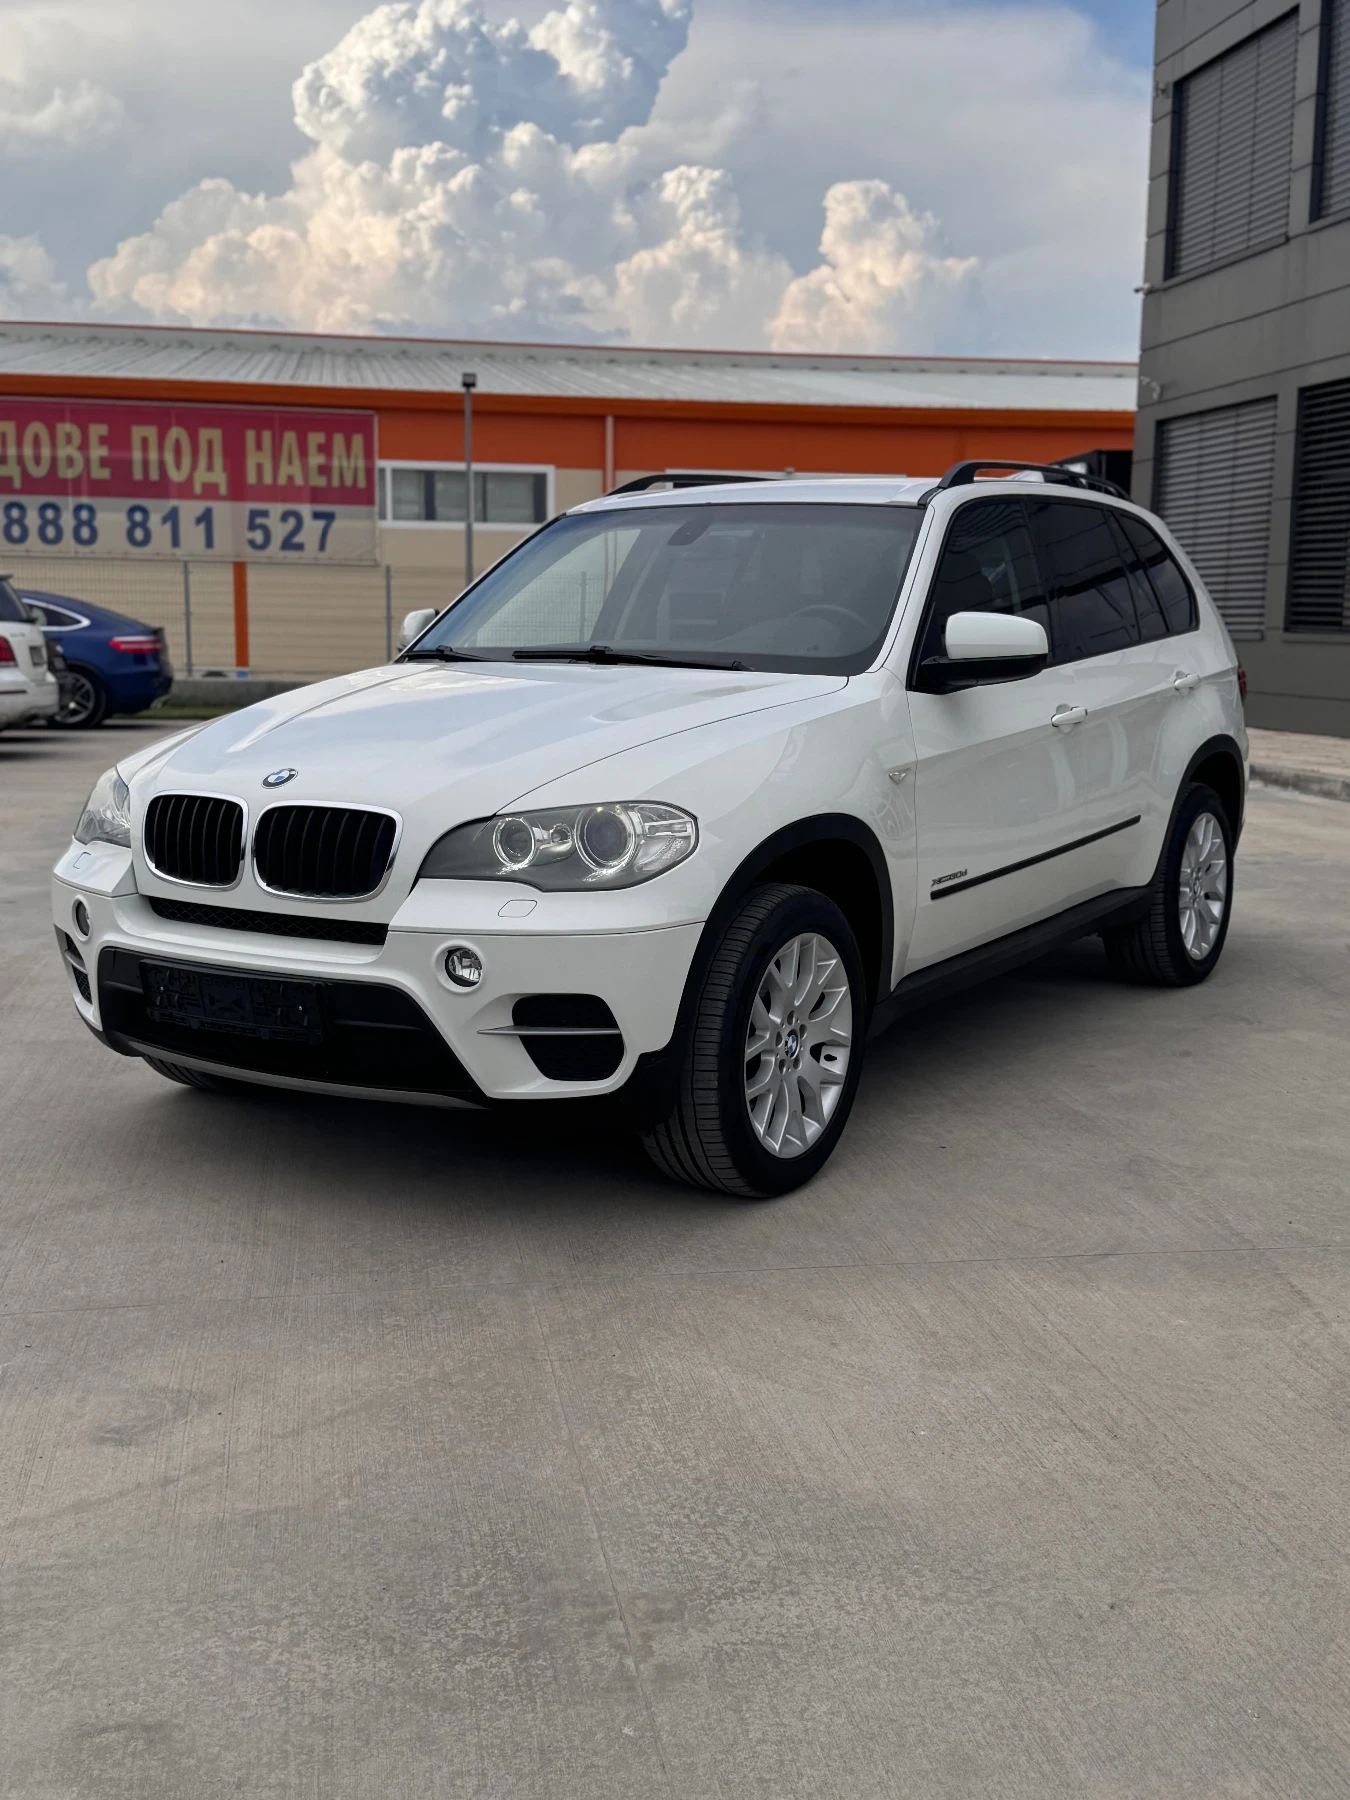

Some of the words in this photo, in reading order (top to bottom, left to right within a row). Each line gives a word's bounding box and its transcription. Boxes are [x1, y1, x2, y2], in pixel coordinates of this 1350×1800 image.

[131, 425, 228, 495] ПОД
[245, 429, 367, 488] НАЕМ
[3, 501, 98, 546] 888
[126, 505, 214, 549] 811
[247, 509, 336, 552] 527
